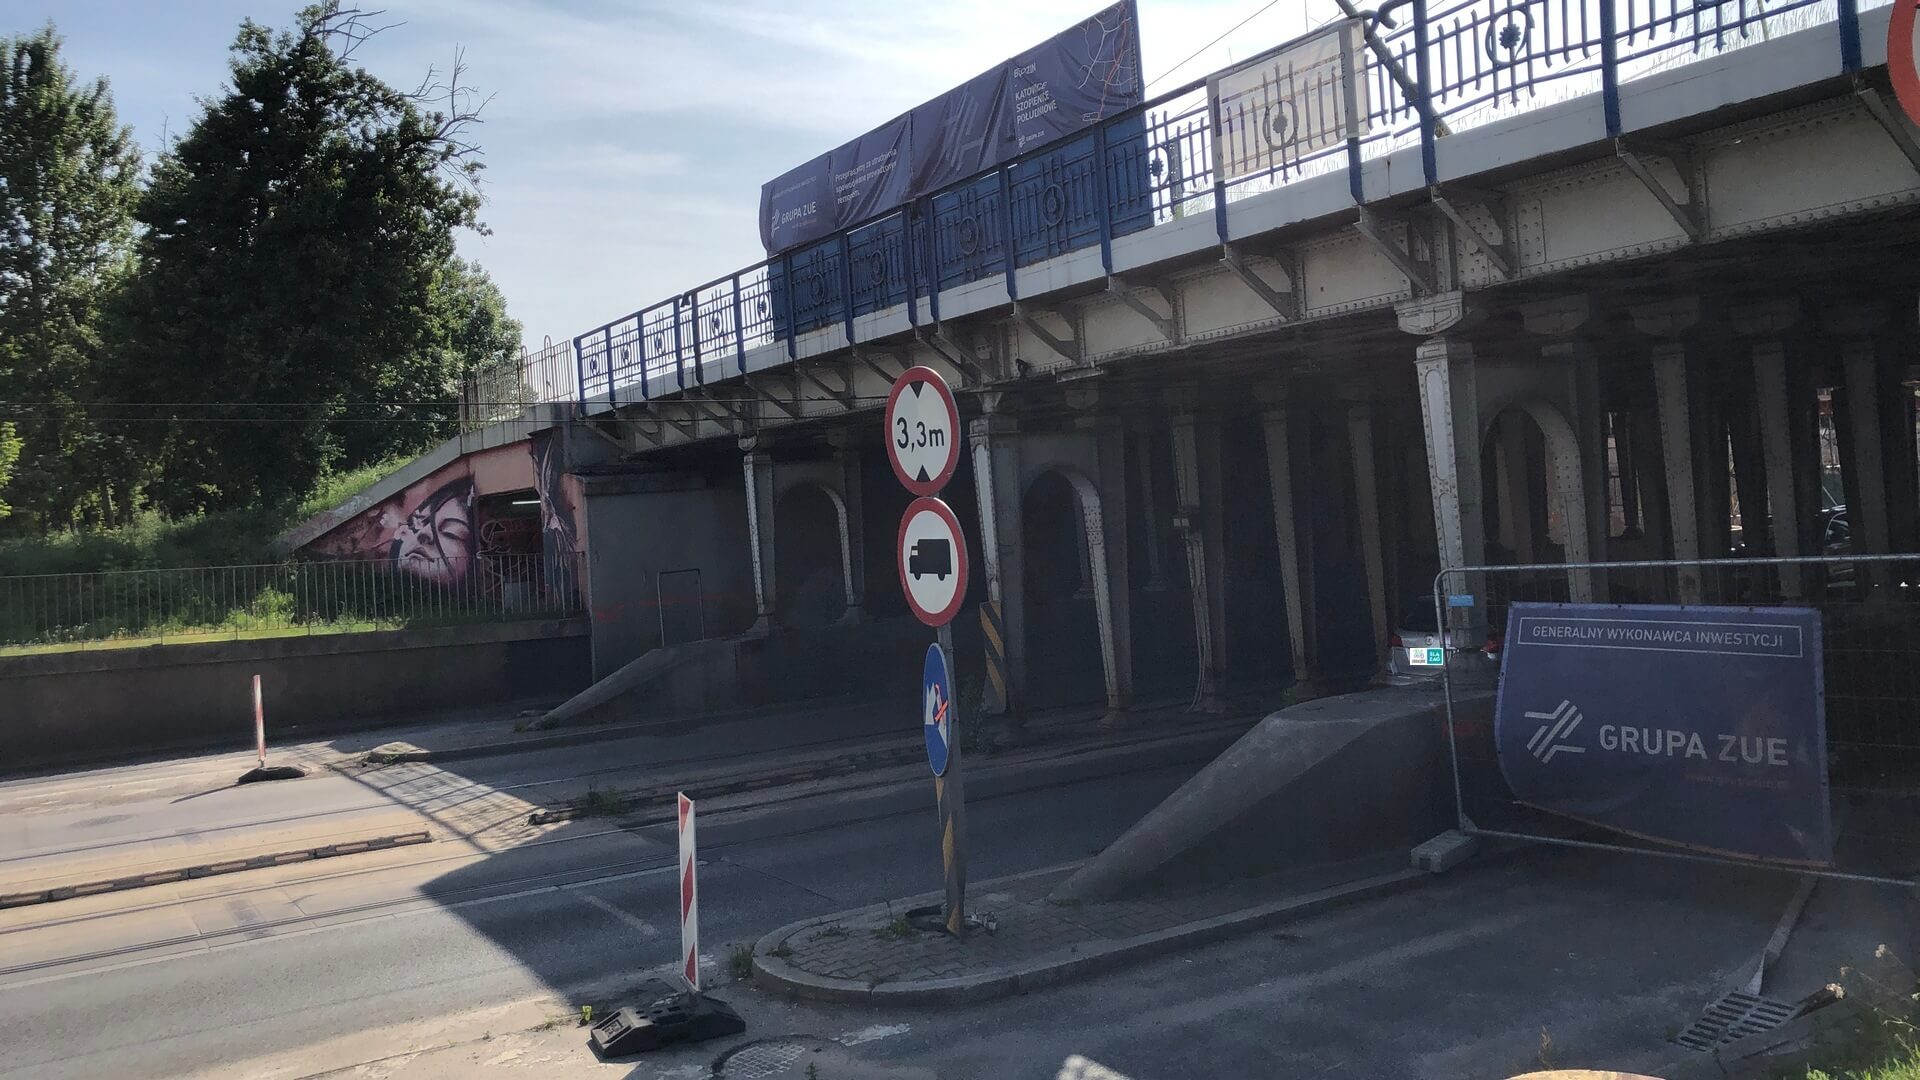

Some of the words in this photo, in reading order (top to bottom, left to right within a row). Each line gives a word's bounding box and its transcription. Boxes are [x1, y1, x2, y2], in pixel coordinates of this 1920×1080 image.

[781, 207, 801, 225] GRUPA
[803, 202, 817, 216] ZUE
[896, 416, 945, 453] 3,3m
[1532, 625, 1604, 639] GENERALNY
[1607, 627, 1692, 643] WYKONAWCA
[1696, 631, 1783, 647] INWESTYCJI
[1599, 724, 1708, 760] GRUPA
[1717, 733, 1789, 766] ZUE
